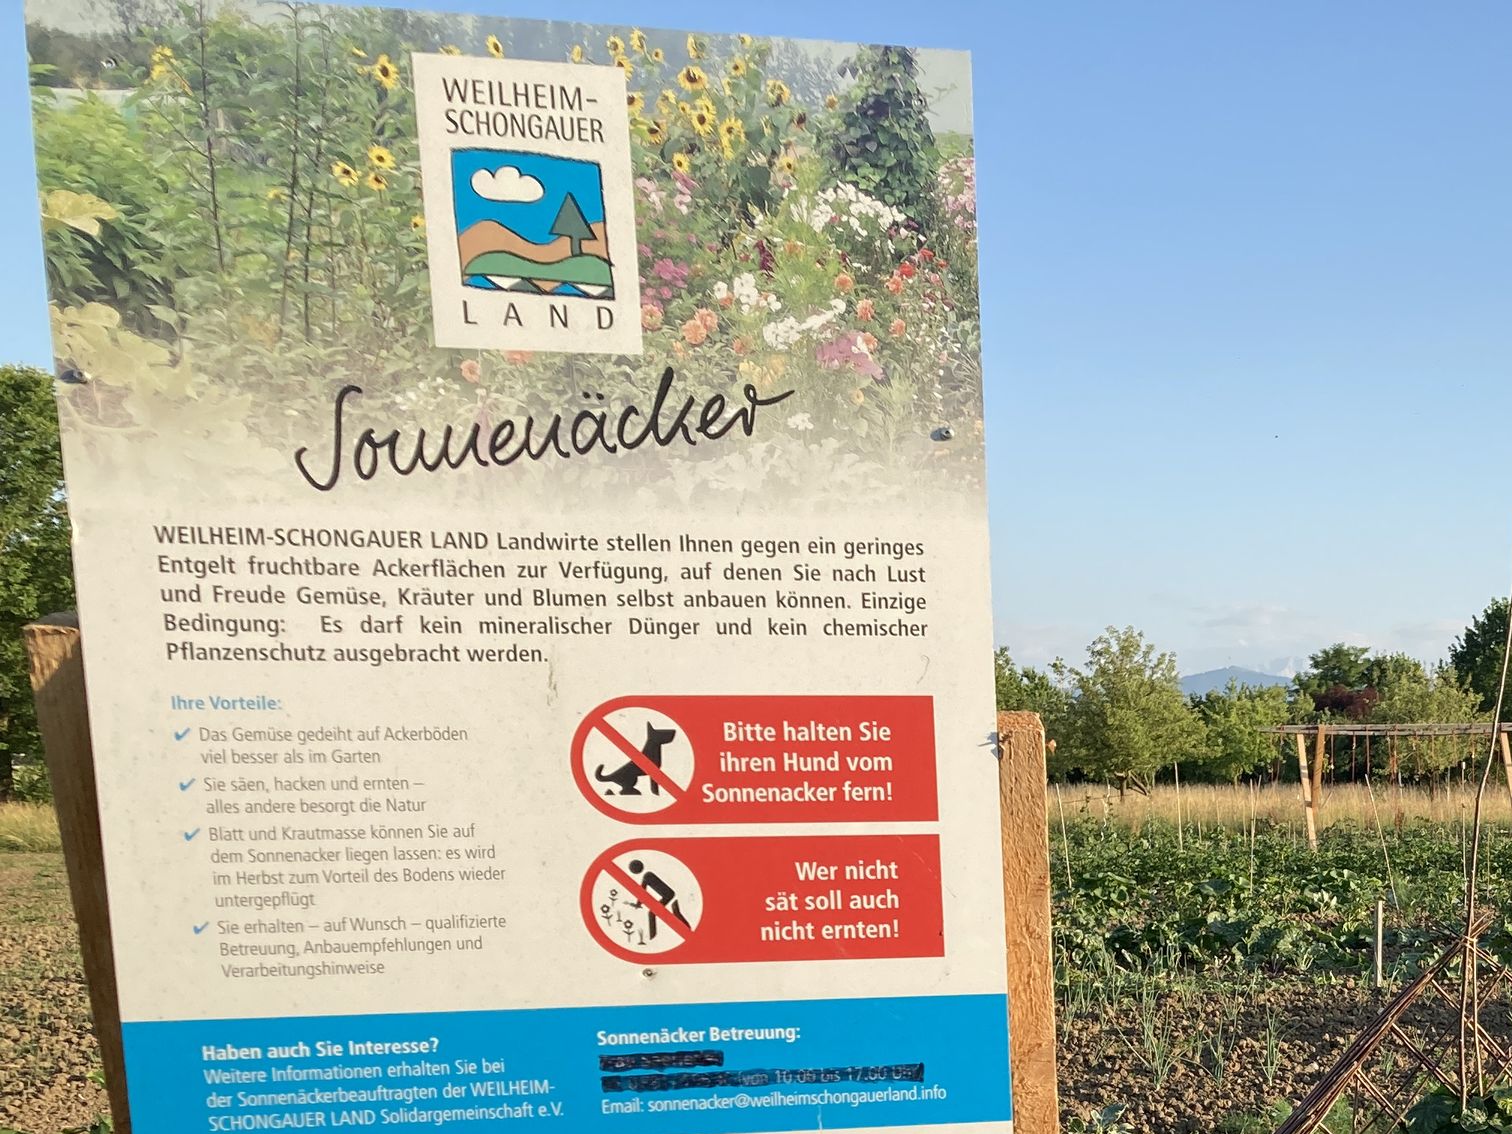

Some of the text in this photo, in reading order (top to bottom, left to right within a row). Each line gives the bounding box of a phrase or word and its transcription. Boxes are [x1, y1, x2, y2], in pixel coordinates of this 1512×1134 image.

[442, 76, 598, 113] WEILHEIM-
[444, 108, 605, 144] SCHONGAUER
[294, 366, 796, 491] Sonnenäcker
[153, 525, 924, 559] WEILHEIM-SCHONGAUER LAND Landwirte stellen Ihnen gegen ein geringes
[157, 554, 926, 583] Entgelt fruchtbare Ackerflächen zur Verfügung, auf denen Sie nach Lust
[160, 584, 927, 613] und Freude Gemüse, Kräuter und Blumen selbst anbauen können. Einzige
[164, 613, 928, 639] Bedingung: Es darf kein mineralischer Dünger und kein chemischer
[166, 642, 548, 666] Pflanzenschutz ausgebracht werden.
[171, 696, 282, 711] Ihre Vorteile:
[199, 727, 468, 745] Das Gemüse gedeiht auf Ackerböden
[723, 721, 891, 742] Bitte halten Sie
[200, 749, 381, 764] viel besser als im Garten
[720, 751, 893, 772] ihren Hund vom
[203, 778, 226, 792] Sie
[230, 778, 270, 794] säen,
[274, 777, 326, 791] hacken
[330, 777, 358, 791] und
[363, 777, 409, 791] ernten
[702, 781, 893, 803] Sonnenacker fern!
[206, 798, 427, 816] alles andere besorgt die Natur
[208, 824, 476, 842] Blatt und Krautmasse können Sie auf
[210, 849, 242, 864] dem
[248, 847, 340, 863] Sonnenacker
[345, 847, 388, 865] liegen
[445, 850, 461, 860] es
[465, 845, 496, 860] wird
[213, 867, 505, 886] im Herbst zum Vorteil des Bodens wieder
[795, 860, 898, 881] Wer nicht
[215, 892, 317, 910] untergepflügt
[765, 889, 899, 911] sät soll auch
[217, 920, 240, 935] Sie
[244, 919, 303, 934] erhalten
[323, 918, 348, 932] auf
[349, 917, 406, 932] Wunsch
[425, 915, 506, 933] qualifizierte
[761, 920, 899, 941] nicht ernten!
[220, 937, 483, 959] Betreuung, Anbauempfehlungen und
[221, 961, 385, 980] Verarbeitungshinweise
[597, 1027, 801, 1046] Sonnenäcker Betreuung:
[202, 1038, 439, 1061] Haben auch Sie Interesse?
[204, 1059, 505, 1085] Weitere Informationen erhalten Sie bei
[206, 1079, 555, 1109] der Sonnenäckerbeauftragten der WEILHEIM-
[602, 1086, 947, 1114] Email: sonnenacker@weilheimschongauerland.info
[208, 1102, 564, 1131] SCHONGAUER LAND Solidargemeinschaft e.V.
